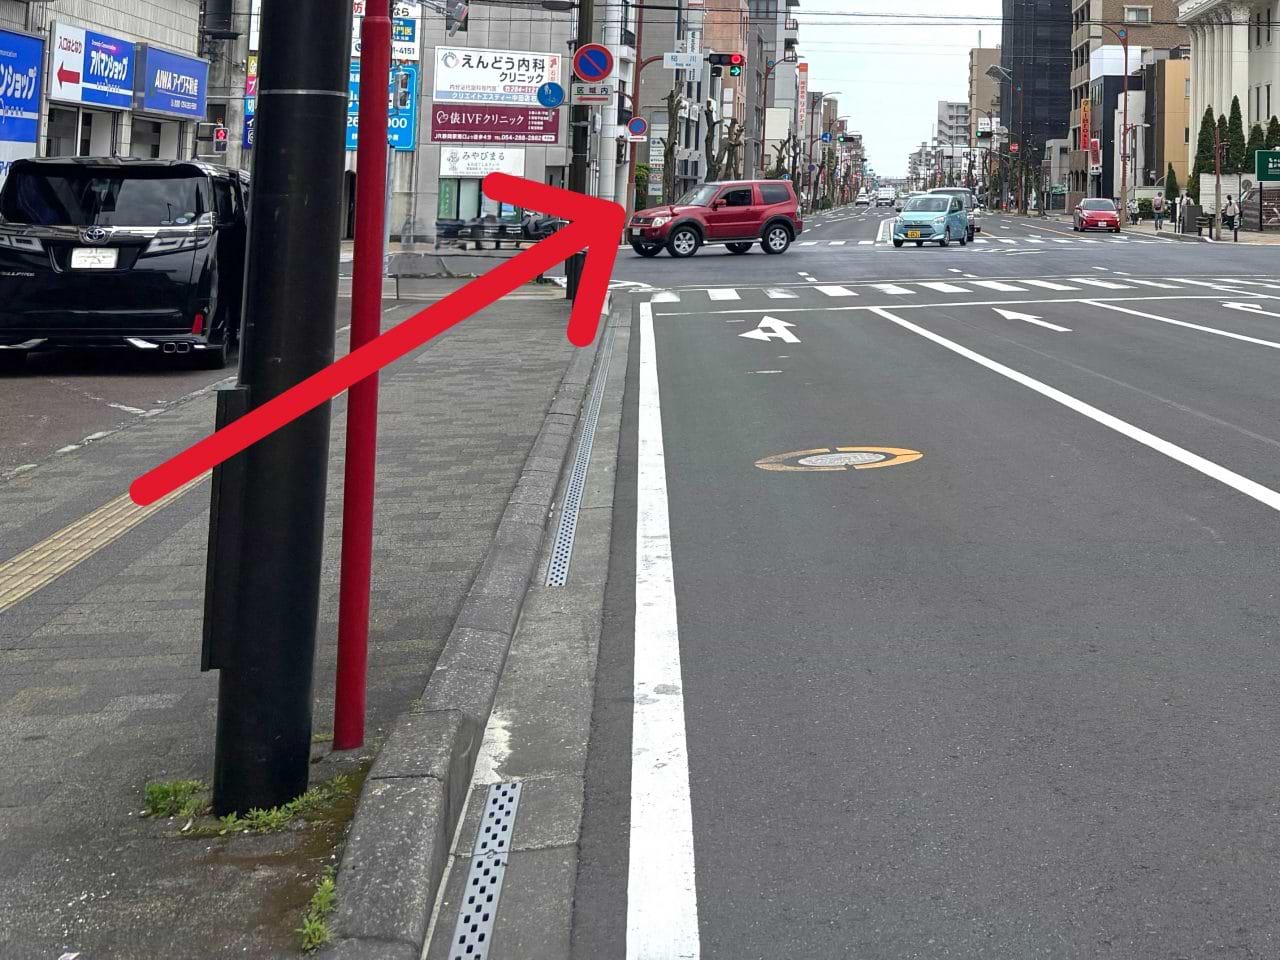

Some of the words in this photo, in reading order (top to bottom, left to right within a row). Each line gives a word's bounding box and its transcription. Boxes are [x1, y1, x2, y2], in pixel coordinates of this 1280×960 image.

[461, 54, 545, 72] えんどう内科
[499, 72, 544, 84] クリニック
